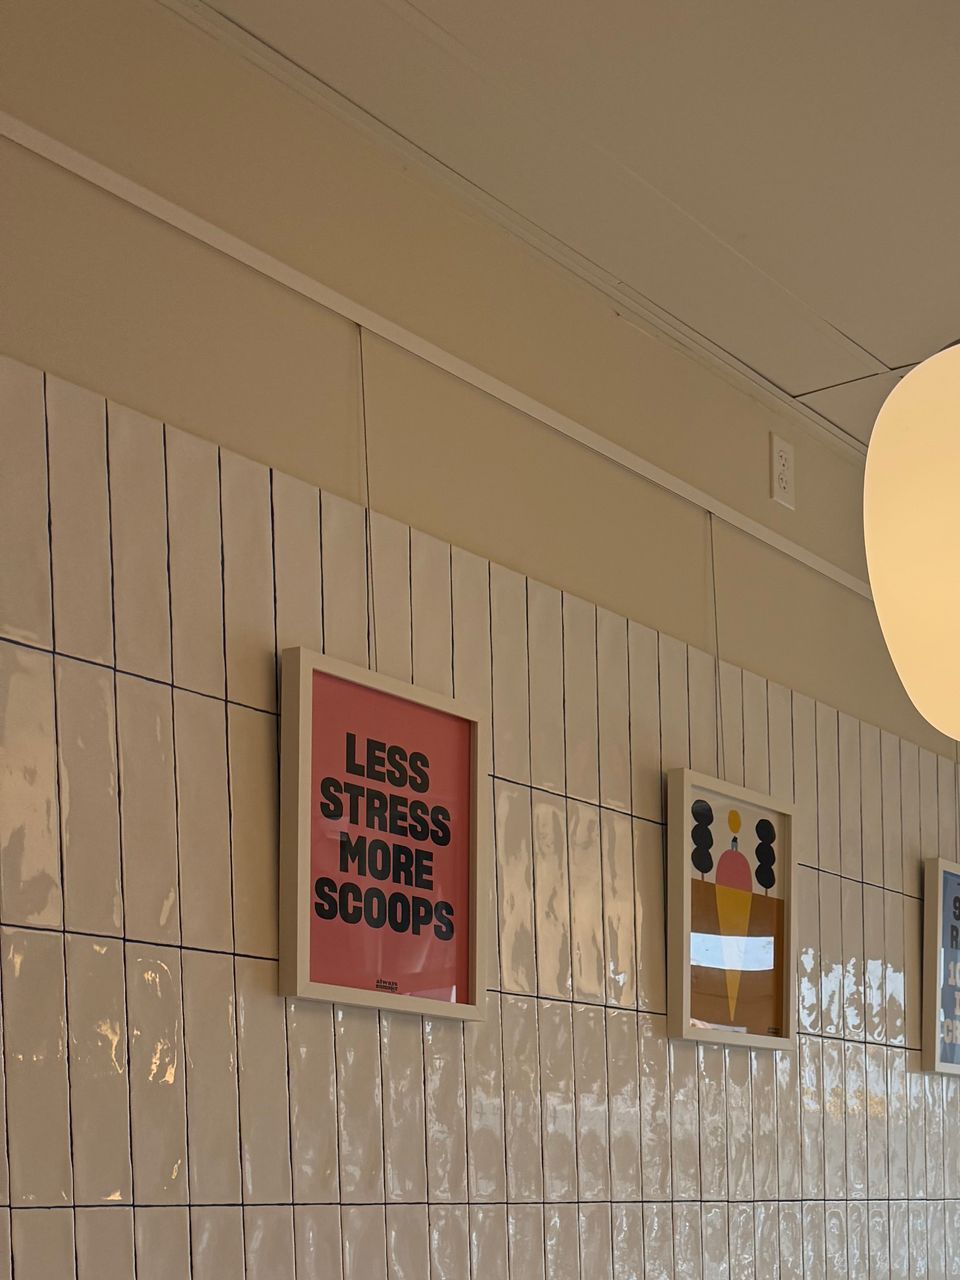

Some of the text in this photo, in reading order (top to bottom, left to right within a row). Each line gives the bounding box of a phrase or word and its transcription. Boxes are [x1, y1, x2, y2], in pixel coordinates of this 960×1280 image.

[345, 732, 430, 793] LESS
[320, 776, 451, 847] STRESS
[339, 831, 434, 891] MORE
[314, 876, 455, 942] SCOOPS
